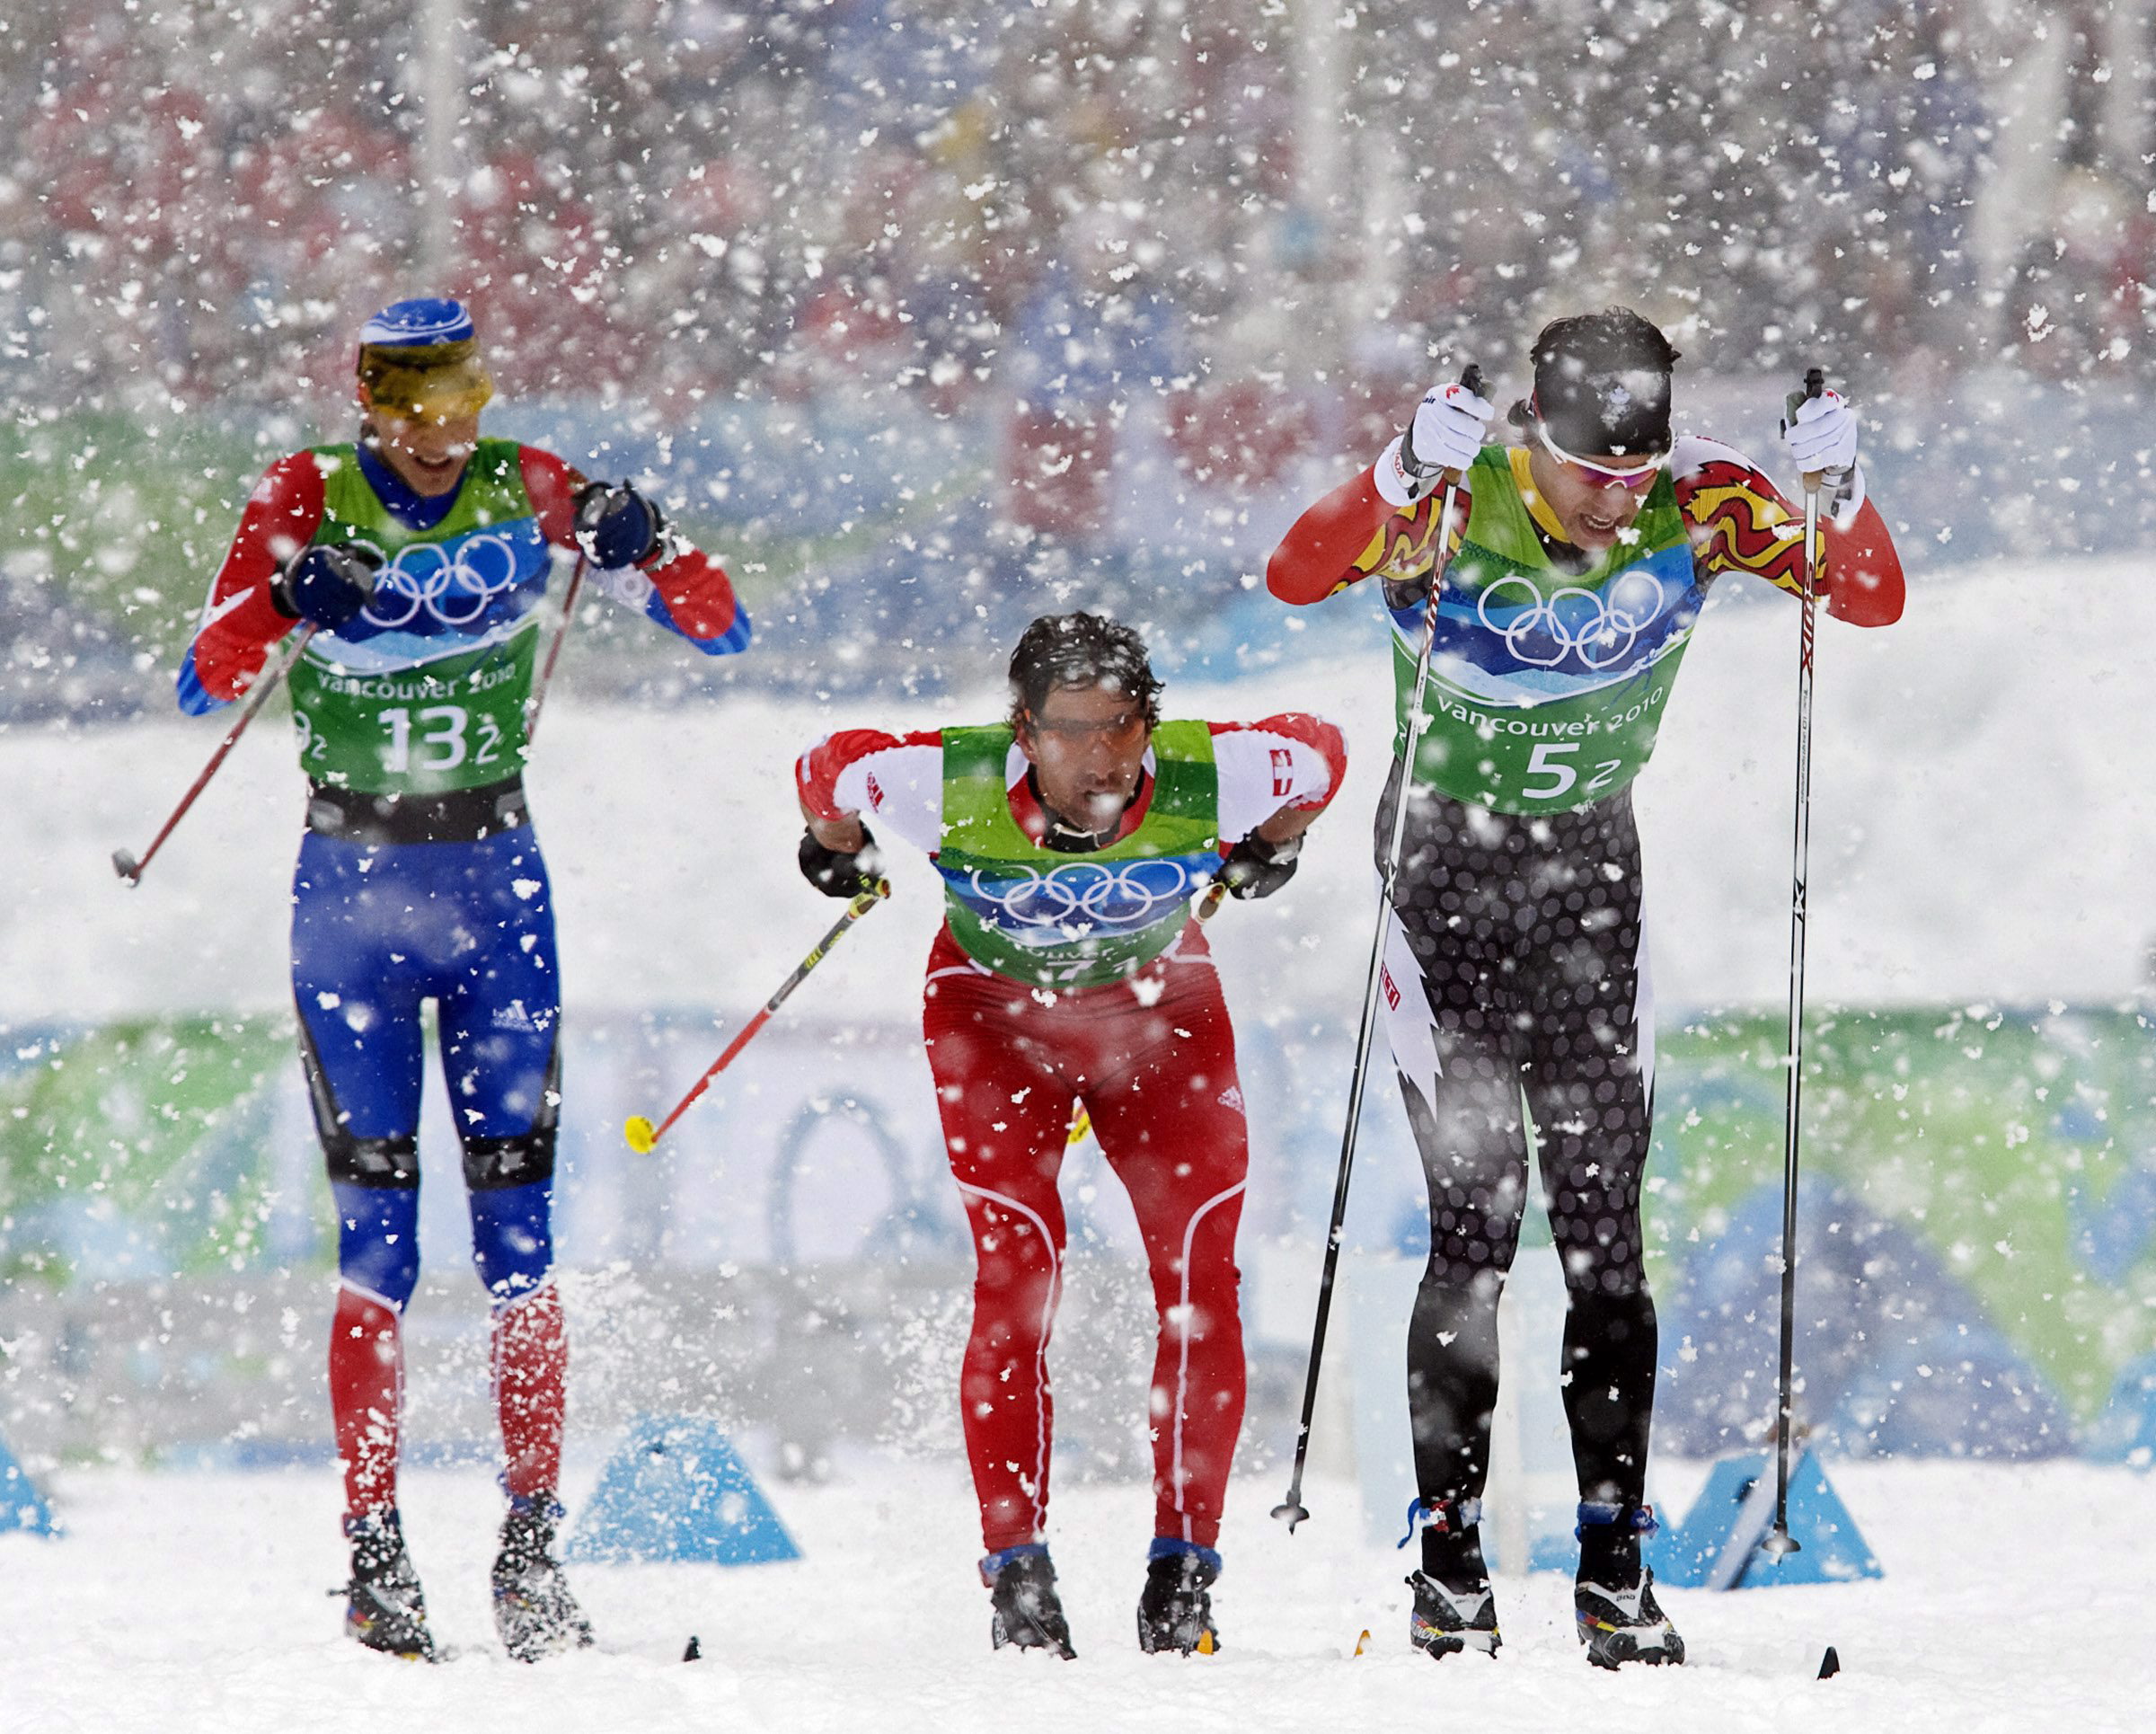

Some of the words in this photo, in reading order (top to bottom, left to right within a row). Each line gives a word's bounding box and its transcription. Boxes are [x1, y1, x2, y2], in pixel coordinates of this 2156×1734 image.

[317, 672, 455, 701] vancouver
[1436, 694, 1601, 738] vancouver
[1609, 686, 1664, 731] 2010
[377, 704, 468, 774] 13
[474, 723, 500, 766] 2
[1522, 741, 1581, 800] 5
[1586, 758, 1621, 791] 2
